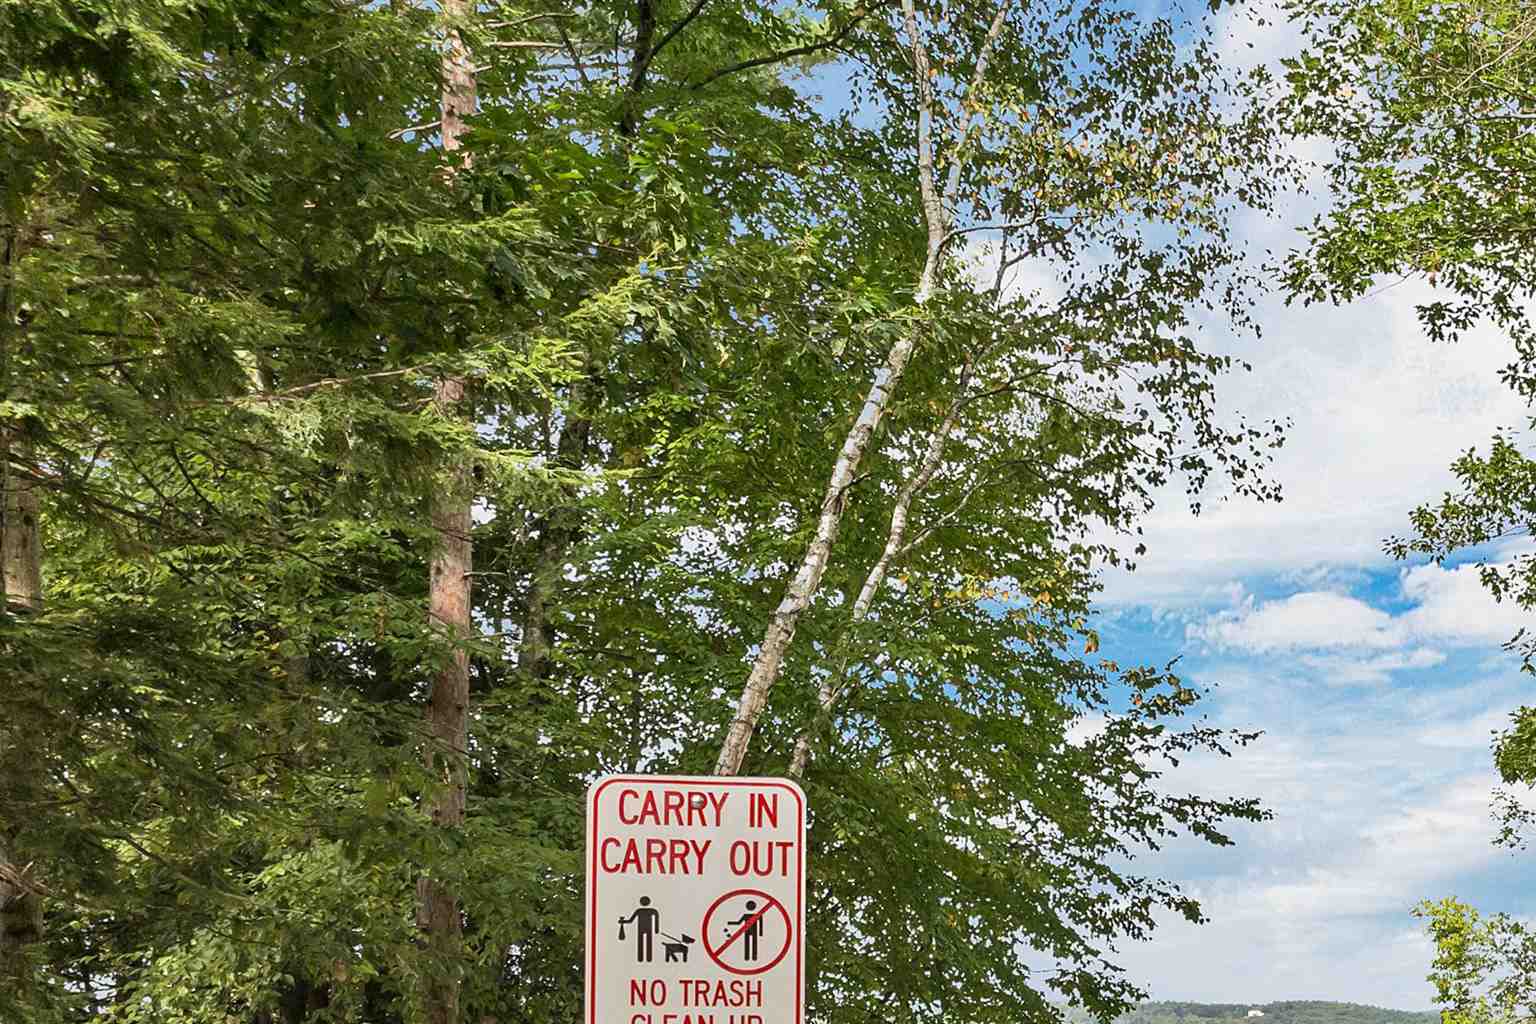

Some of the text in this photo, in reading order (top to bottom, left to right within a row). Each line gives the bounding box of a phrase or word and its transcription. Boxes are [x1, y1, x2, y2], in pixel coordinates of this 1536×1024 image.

[618, 789, 778, 828] CARRY IN
[600, 838, 794, 877] CARRY OUT
[630, 979, 762, 1007] NO TRASH
